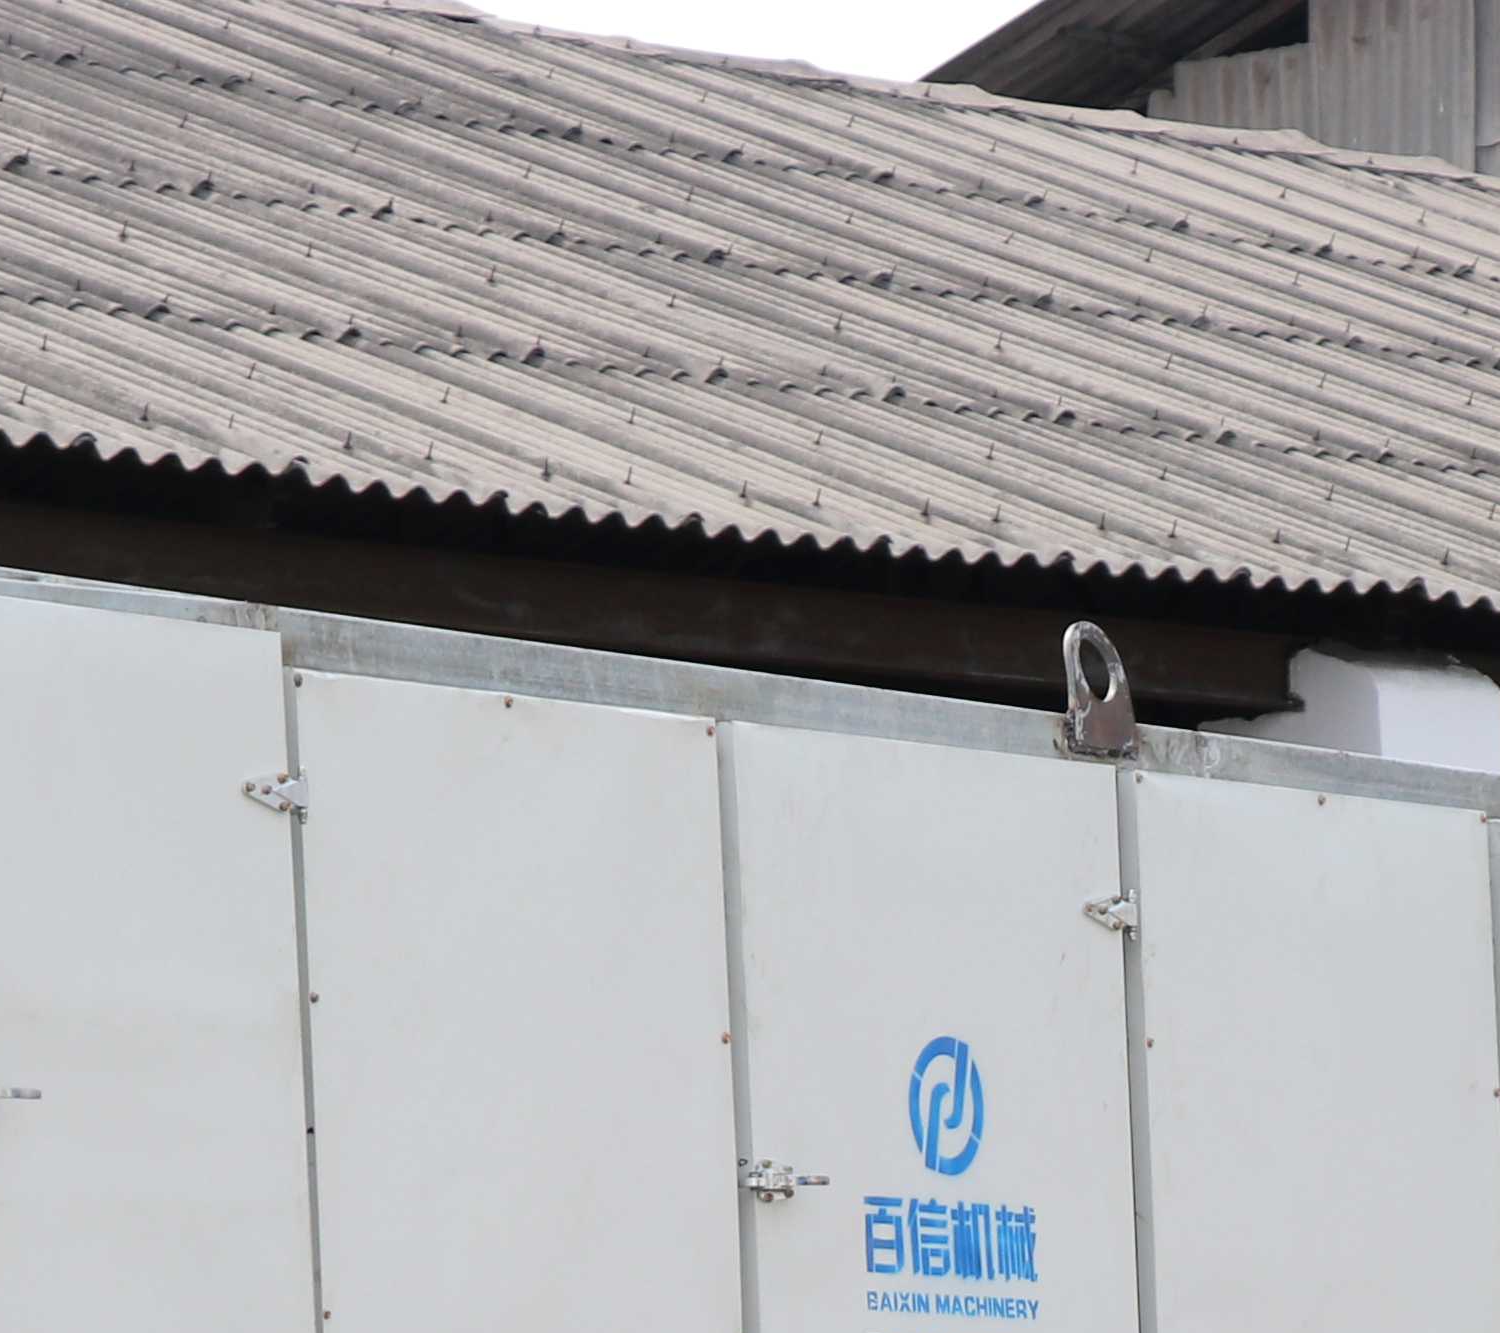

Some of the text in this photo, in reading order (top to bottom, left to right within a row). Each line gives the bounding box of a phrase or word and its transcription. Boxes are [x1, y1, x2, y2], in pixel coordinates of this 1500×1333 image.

[863, 1196, 1038, 1283] 百信机械
[866, 1291, 1039, 1321] BAIXIN MACHINERY
